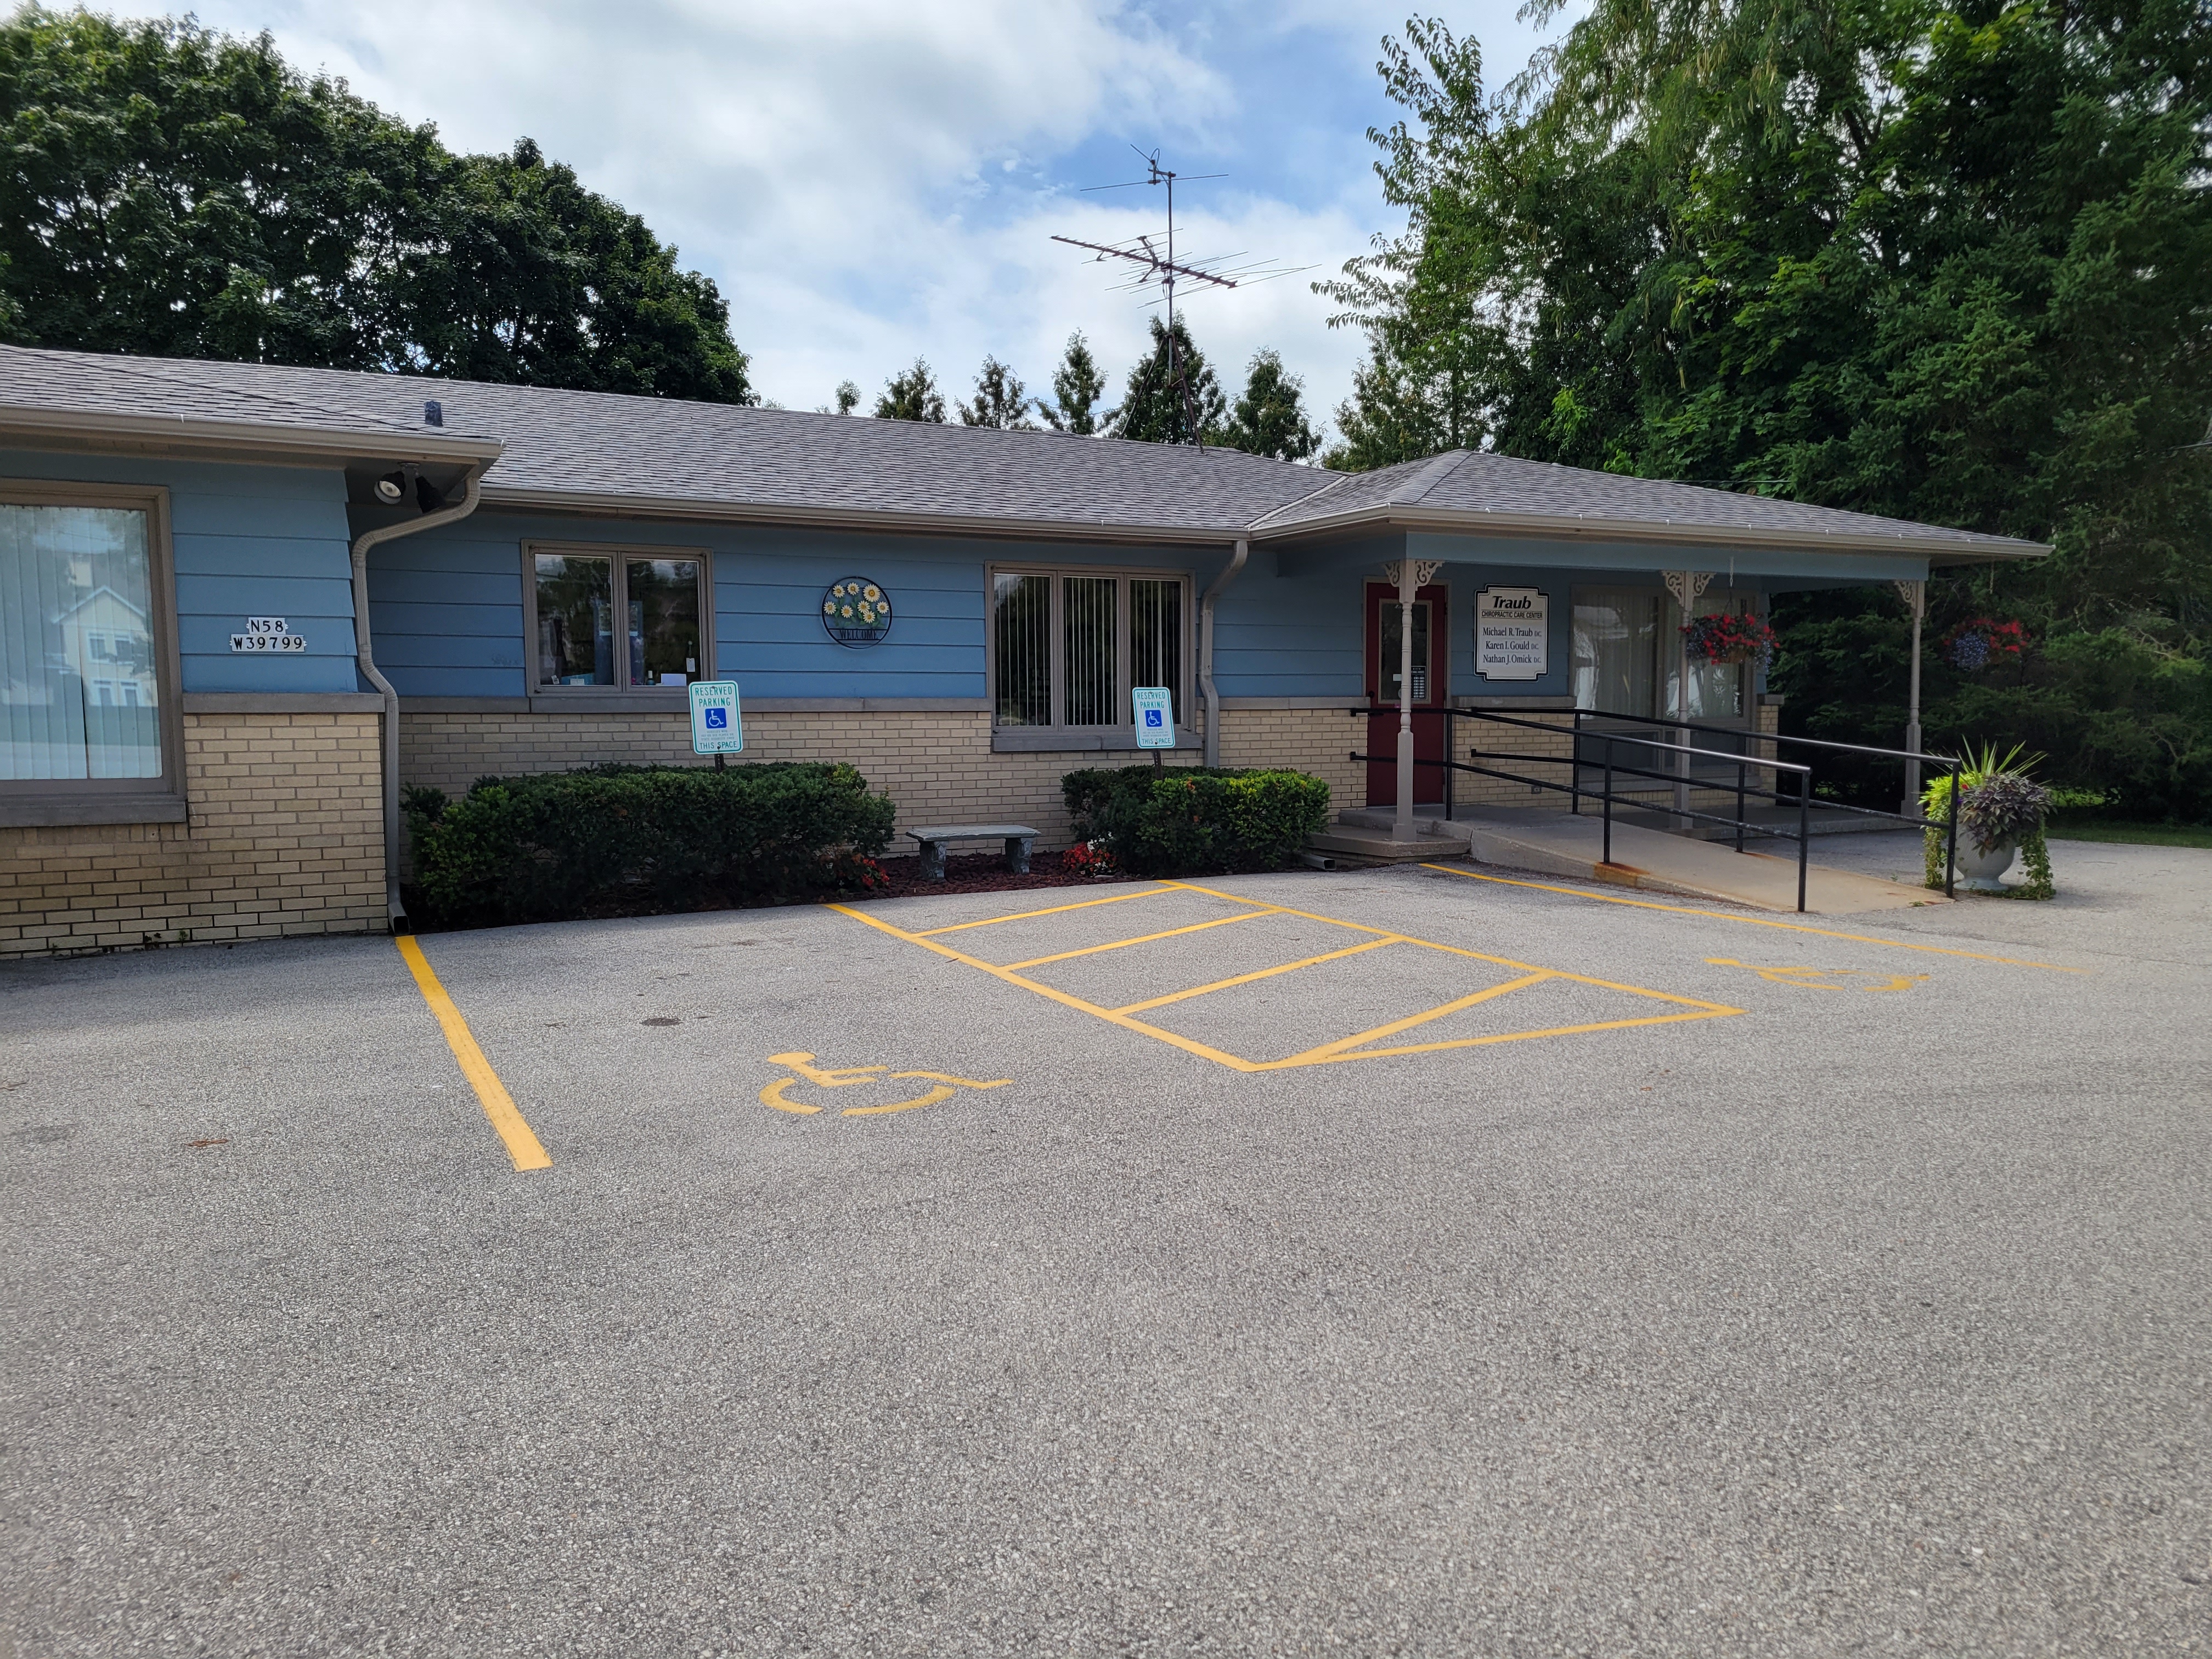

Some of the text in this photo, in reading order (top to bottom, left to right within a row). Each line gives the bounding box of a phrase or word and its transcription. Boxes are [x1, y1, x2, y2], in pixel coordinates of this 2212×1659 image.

[1493, 596, 1532, 609] Traub
[250, 619, 284, 633] N58
[839, 629, 877, 640] WELCOME
[1482, 627, 1507, 636] Michael
[1509, 627, 1515, 636] R.
[1515, 627, 1533, 637] Traub
[233, 637, 302, 650] W39799
[1486, 641, 1504, 650] Karen
[1510, 640, 1530, 650] Gould
[1483, 654, 1505, 663] Nathan
[1505, 654, 1511, 665] J.
[1511, 654, 1532, 663] Omick
[695, 686, 732, 696] RESERVED
[698, 697, 731, 707] PARKING
